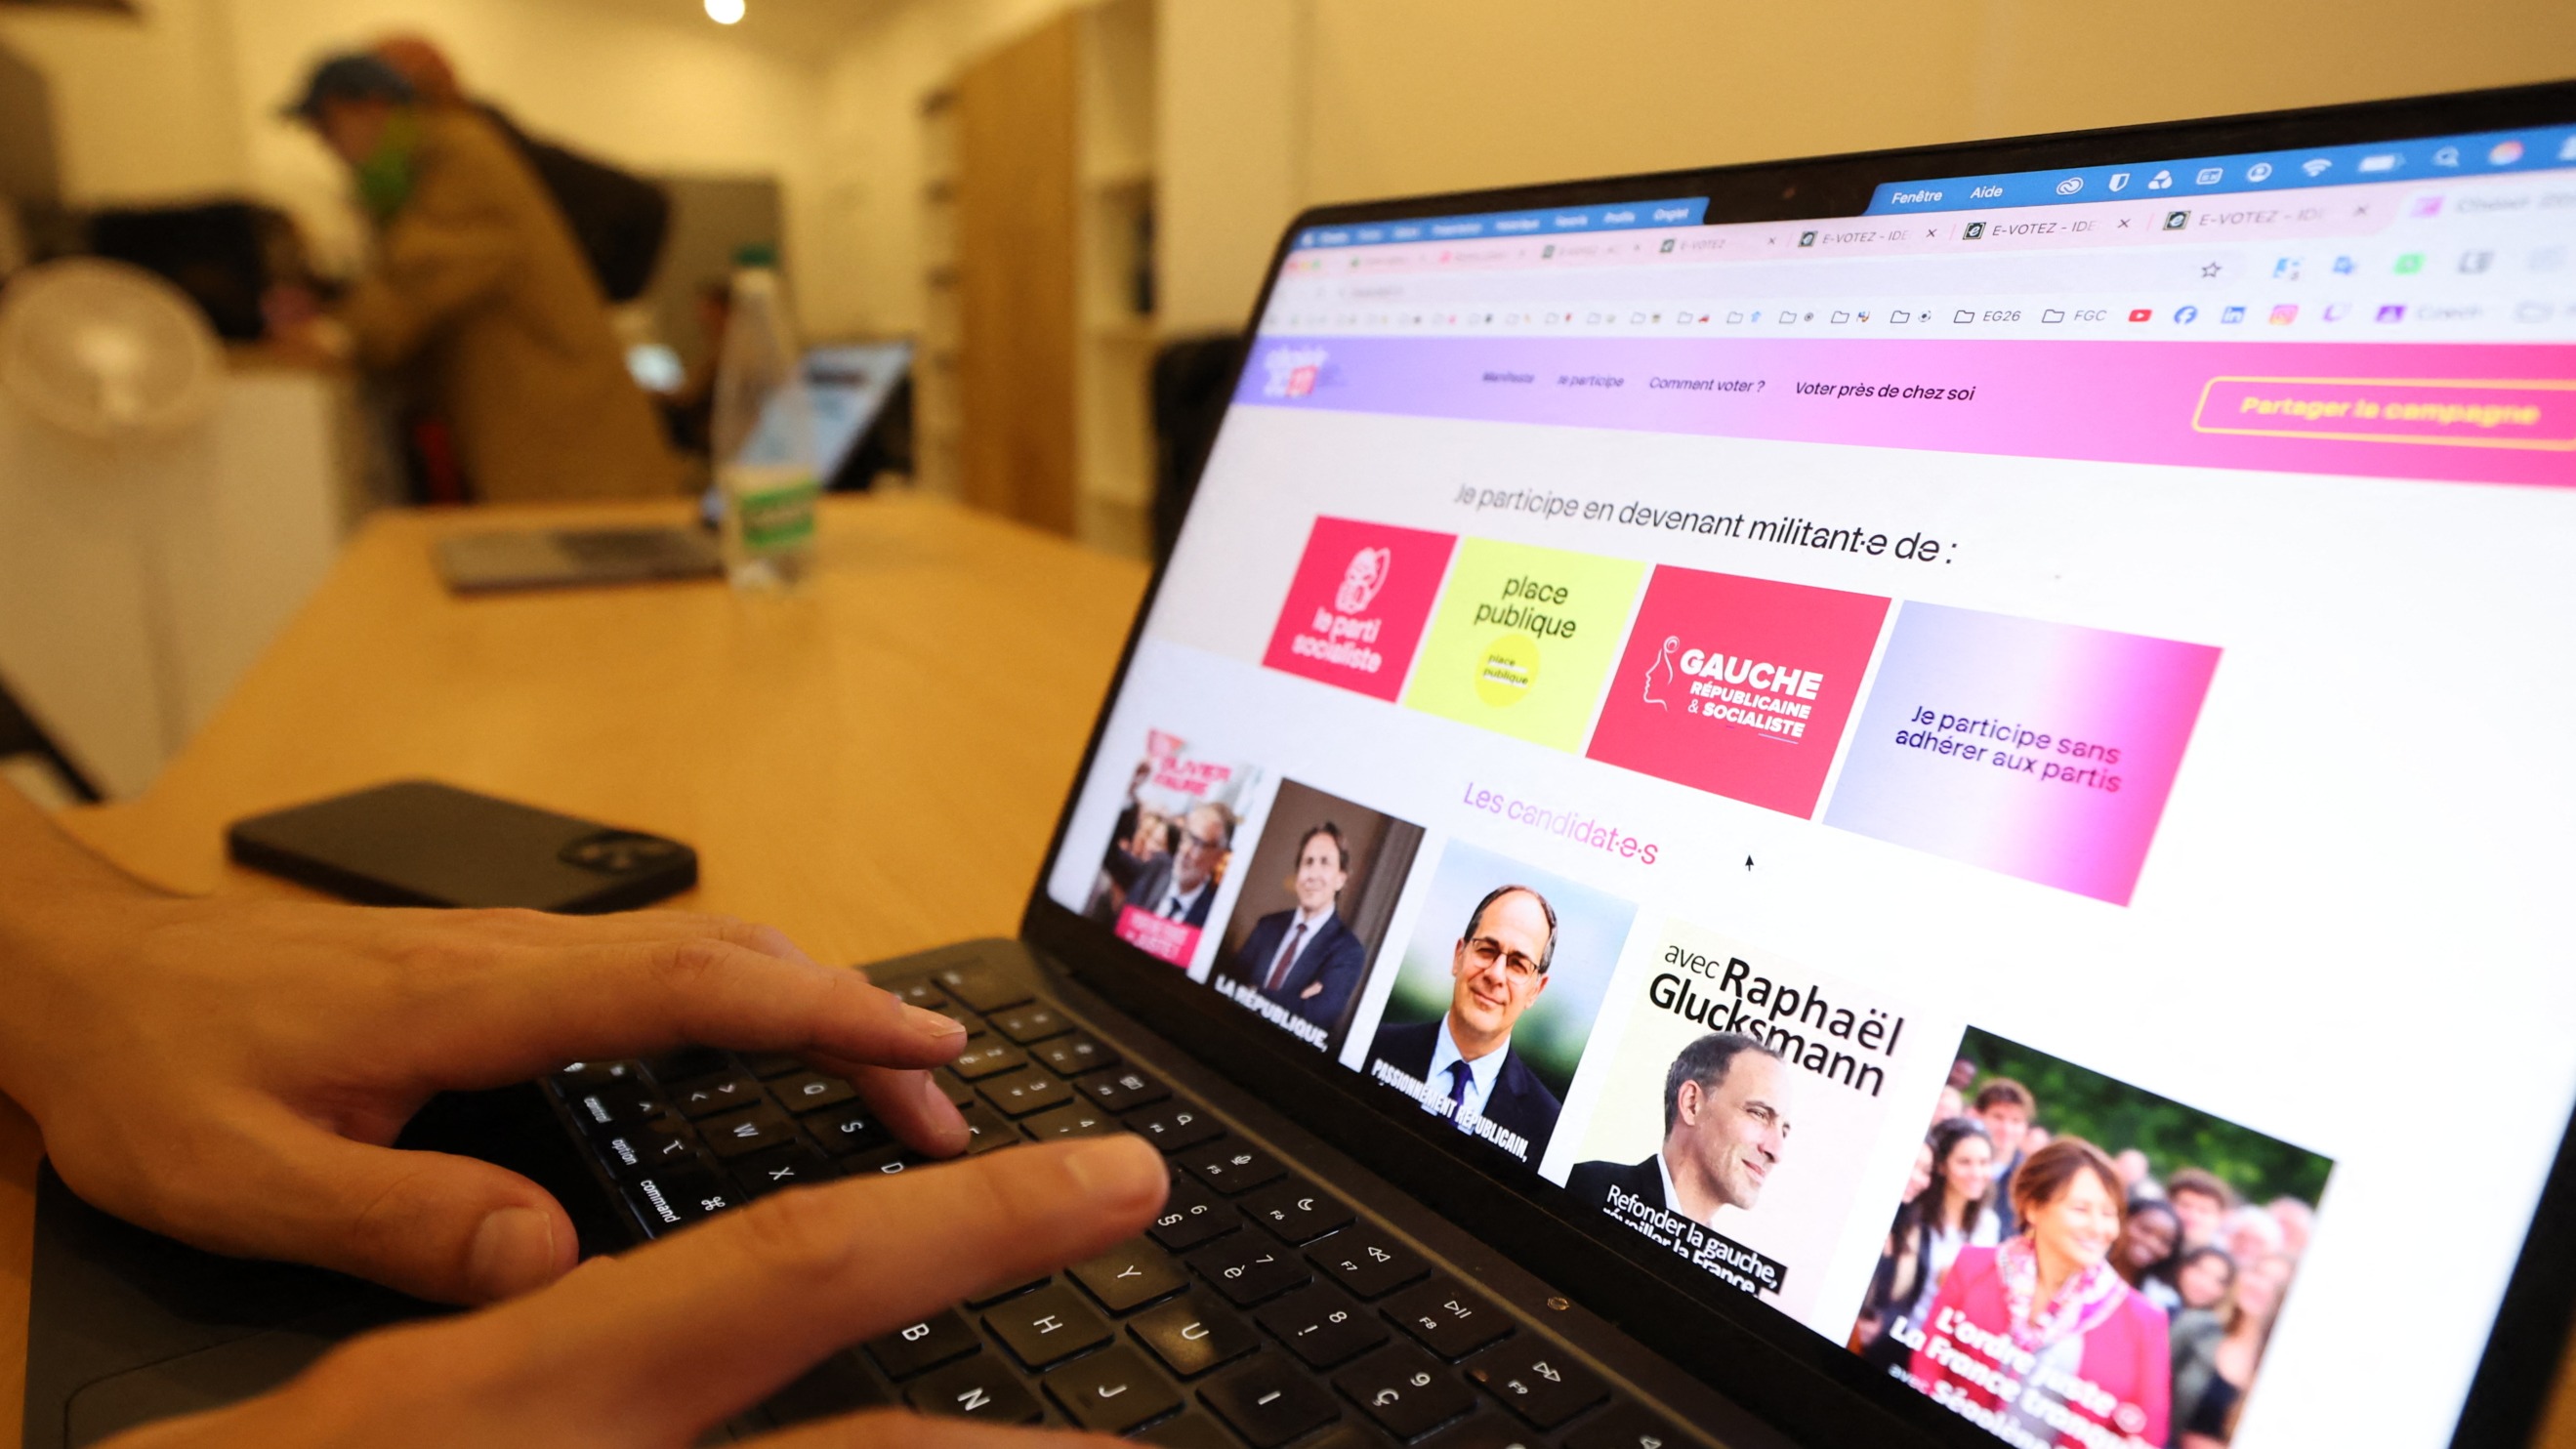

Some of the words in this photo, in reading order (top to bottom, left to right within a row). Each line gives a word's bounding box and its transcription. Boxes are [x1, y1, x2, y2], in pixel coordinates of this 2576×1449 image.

[1891, 188, 1942, 205] Fenêtre
[1970, 185, 2003, 199] Aide
[2199, 210, 2279, 227] E-VOTEZ
[1822, 231, 1876, 244] E-VOTEZ
[1992, 222, 2057, 236] E-VOTEZ
[1983, 310, 2021, 322] EG26
[2074, 310, 2107, 322] FGC
[1568, 374, 1624, 389] participe
[1648, 377, 1714, 392] Comment
[1717, 379, 1754, 393] voter
[1758, 380, 1766, 393] ?
[1796, 381, 1837, 395] Voter
[1837, 382, 1875, 398] près
[1877, 384, 1899, 398] de
[1902, 385, 1945, 400] chez
[1946, 386, 1976, 401] soi
[2240, 396, 2351, 421] Partager
[2354, 398, 2380, 419] le
[2385, 402, 2541, 429] campagne
[1455, 483, 1475, 504] Je
[1476, 487, 1579, 520] participe
[1583, 500, 1614, 521] en
[1618, 501, 1745, 538] devenant
[1893, 532, 1941, 562] de
[1945, 543, 1957, 564] :
[1502, 575, 1569, 604] place
[1311, 606, 1334, 634] le
[1329, 615, 1382, 644] parti
[1474, 601, 1577, 639] publique
[1291, 633, 1383, 673] socialiste
[1488, 653, 1516, 668] place
[1483, 667, 1529, 685] publique
[1680, 647, 1824, 701] GAUCHE
[1689, 681, 1812, 720] RÉPUBLICAINE
[1687, 699, 1700, 714] &
[1702, 701, 1807, 739] SOCIALISTE
[1911, 705, 1935, 725] Je
[1937, 712, 2052, 750] participe
[2056, 737, 2123, 766] sans
[1895, 729, 1988, 763] adhérer
[1992, 751, 2038, 773] aux
[2040, 761, 2123, 794] partis
[1463, 782, 1504, 814] Les
[1507, 800, 1658, 865] candidat·e·s
[1215, 973, 1236, 998] LA
[1664, 944, 1720, 979] avec
[1719, 957, 1905, 1056] Raphaël
[1649, 972, 1887, 1097] Glucksmann
[733, 1123, 759, 1138] W
[841, 1121, 863, 1133] S
[611, 1138, 637, 1166] option
[769, 1166, 795, 1180] X
[881, 1162, 904, 1174] D
[1207, 1164, 1223, 1175] F5
[641, 1180, 681, 1222] command
[1190, 1204, 1208, 1215] 6
[1269, 1210, 1285, 1221] F6
[1606, 1183, 1686, 1237] Refonder
[1685, 1222, 1704, 1248] la
[1703, 1236, 1778, 1289] gauche,
[1256, 1254, 1274, 1263] 7
[1341, 1260, 1358, 1271] F7
[1116, 1264, 1143, 1280] Y
[1224, 1264, 1245, 1279] è
[1033, 1314, 1063, 1335] H
[1328, 1310, 1348, 1324] 8
[1418, 1316, 1438, 1330] F8
[901, 1323, 931, 1343] B
[1181, 1322, 1210, 1341] U
[1933, 1305, 2036, 1375] L'ordre
[1889, 1314, 1927, 1351] La
[1925, 1335, 2021, 1403] France
[1410, 1372, 1431, 1387] 9
[1508, 1380, 1528, 1394] F9
[1889, 1363, 1931, 1394] avec
[957, 1387, 991, 1412] N
[1098, 1385, 1128, 1399] J
